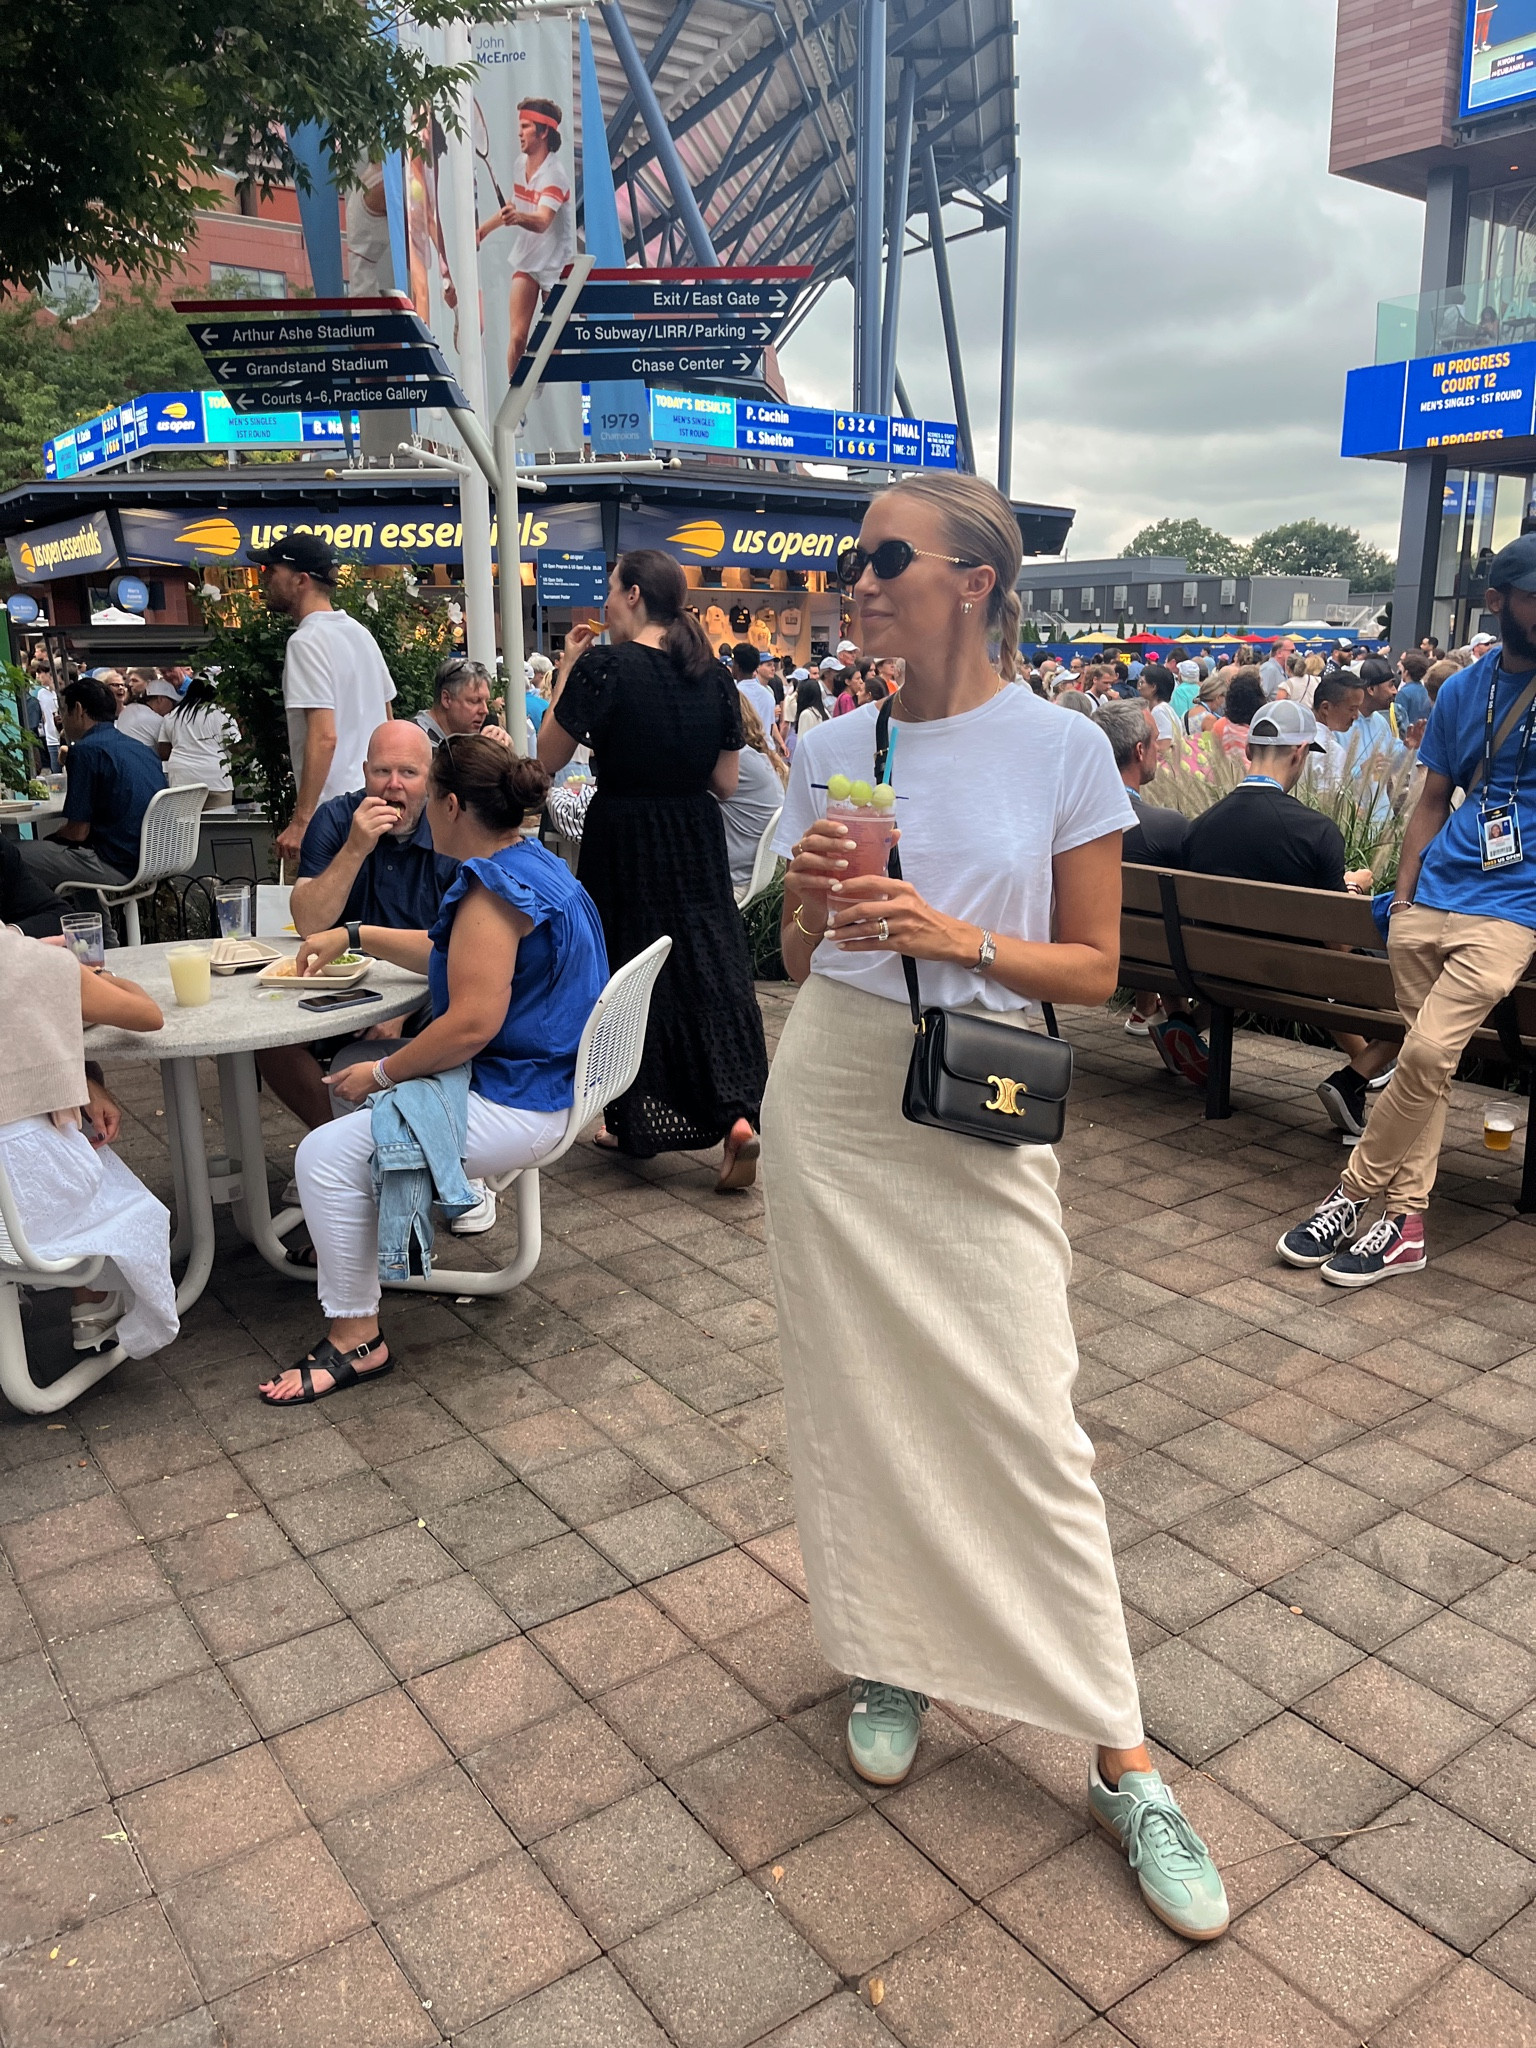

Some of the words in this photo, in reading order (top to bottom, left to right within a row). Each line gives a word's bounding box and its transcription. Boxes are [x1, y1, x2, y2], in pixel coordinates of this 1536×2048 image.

[476, 36, 505, 50] John
[476, 50, 527, 64] McEnroe
[653, 292, 681, 306] Exit
[692, 292, 723, 306] East
[726, 291, 760, 306] Gate
[232, 327, 274, 343] Arthur
[279, 326, 313, 341] Ashe
[317, 324, 375, 340] Stadium
[575, 327, 590, 341] To
[246, 360, 326, 377] Grandstand
[331, 357, 388, 374] Stadium
[631, 359, 675, 373] Chase
[678, 357, 725, 371] Center
[1432, 362, 1445, 377] IN
[1447, 351, 1510, 375] PROGRESS
[1441, 374, 1481, 394] COURT
[1483, 372, 1497, 388] 12
[261, 389, 302, 406] Courts
[333, 388, 383, 404] Practice
[385, 386, 428, 403] Gallery
[1420, 399, 1443, 412] MEN'S
[1444, 395, 1475, 409] SINGLES
[1481, 392, 1494, 403] 1ST
[1494, 388, 1523, 402] ROUND
[655, 394, 693, 411] TODAY'S
[694, 398, 732, 415] RESULTS
[228, 417, 249, 426] MEN'S
[250, 416, 277, 426] SINGLES
[600, 413, 640, 429] 1979
[673, 415, 691, 425] MEN'S
[691, 416, 715, 427] SINGLES
[746, 406, 756, 421] P.
[757, 407, 789, 424] Cachin
[170, 420, 196, 434] open
[247, 430, 271, 438] ROUND
[679, 428, 689, 437] 1ST
[689, 429, 710, 438] ROUND
[892, 422, 920, 440] FINAL
[746, 430, 757, 444] B.
[758, 431, 794, 447] Shelton
[906, 445, 918, 456] 2:07
[931, 443, 950, 458] IBM
[250, 524, 288, 549] us
[32, 545, 45, 567] us
[42, 541, 63, 572] open
[59, 522, 102, 561] essentials
[732, 529, 767, 554] us
[767, 531, 835, 563] open
